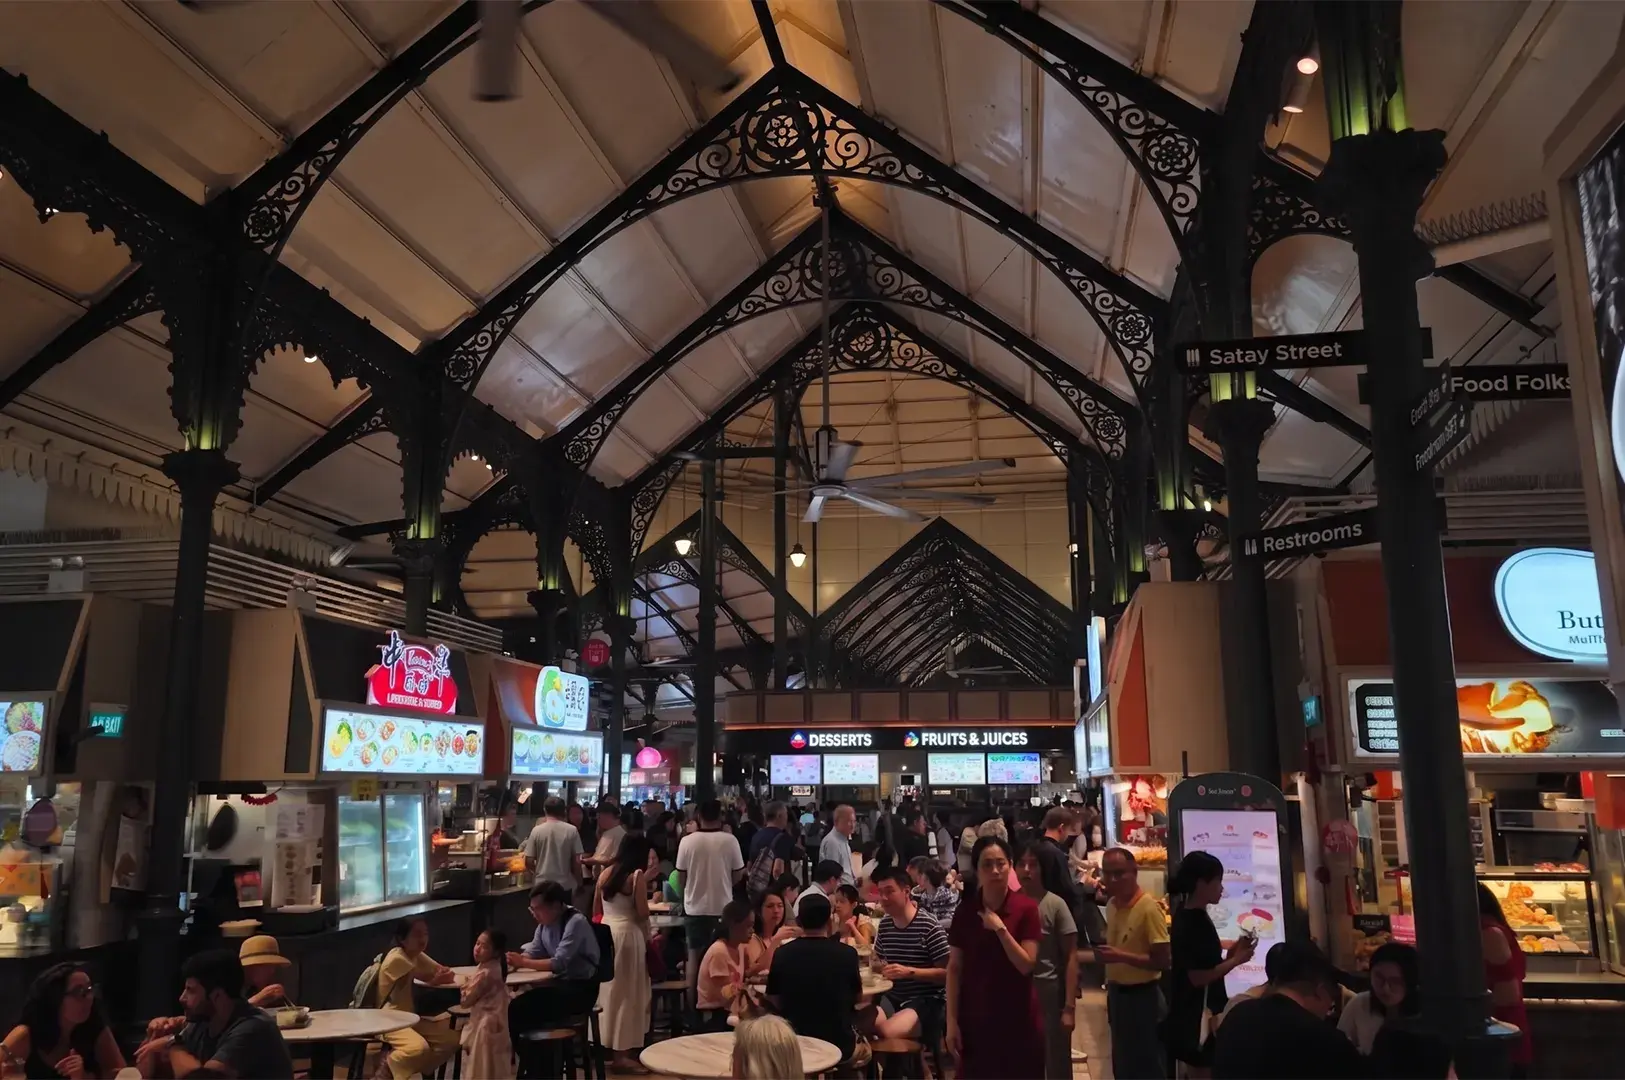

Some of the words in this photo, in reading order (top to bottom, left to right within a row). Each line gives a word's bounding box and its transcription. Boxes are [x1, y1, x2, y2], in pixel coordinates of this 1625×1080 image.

[1210, 348, 1269, 365] Satay
[1275, 342, 1343, 361] Street
[1451, 375, 1509, 393] Food
[1263, 523, 1363, 553] Restrooms
[808, 732, 872, 747] DESSERTS
[921, 732, 967, 746] FRUITS
[968, 732, 980, 746] &
[981, 732, 1028, 746] JUICES
